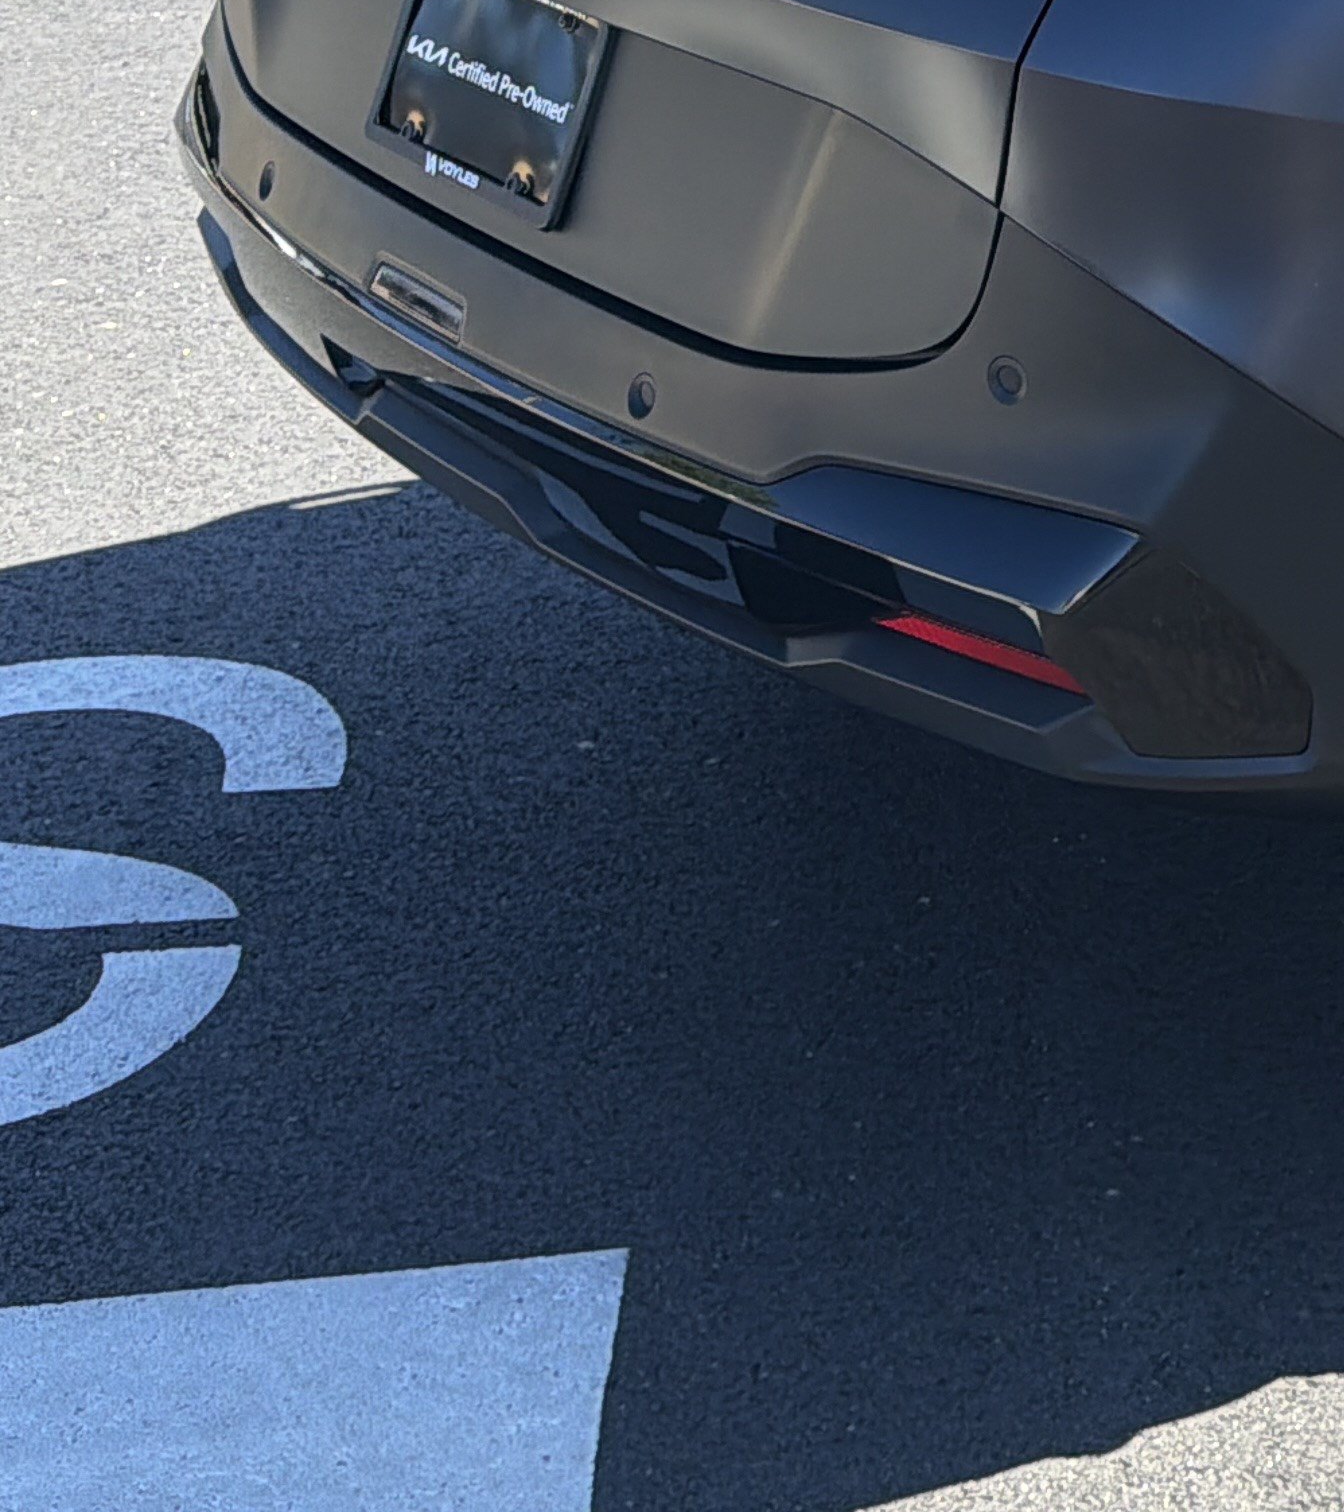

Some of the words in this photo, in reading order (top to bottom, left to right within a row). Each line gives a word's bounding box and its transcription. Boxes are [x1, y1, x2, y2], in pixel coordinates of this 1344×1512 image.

[406, 34, 450, 68] KIA
[448, 51, 501, 94] Certified
[498, 74, 570, 125] Pre-Owned
